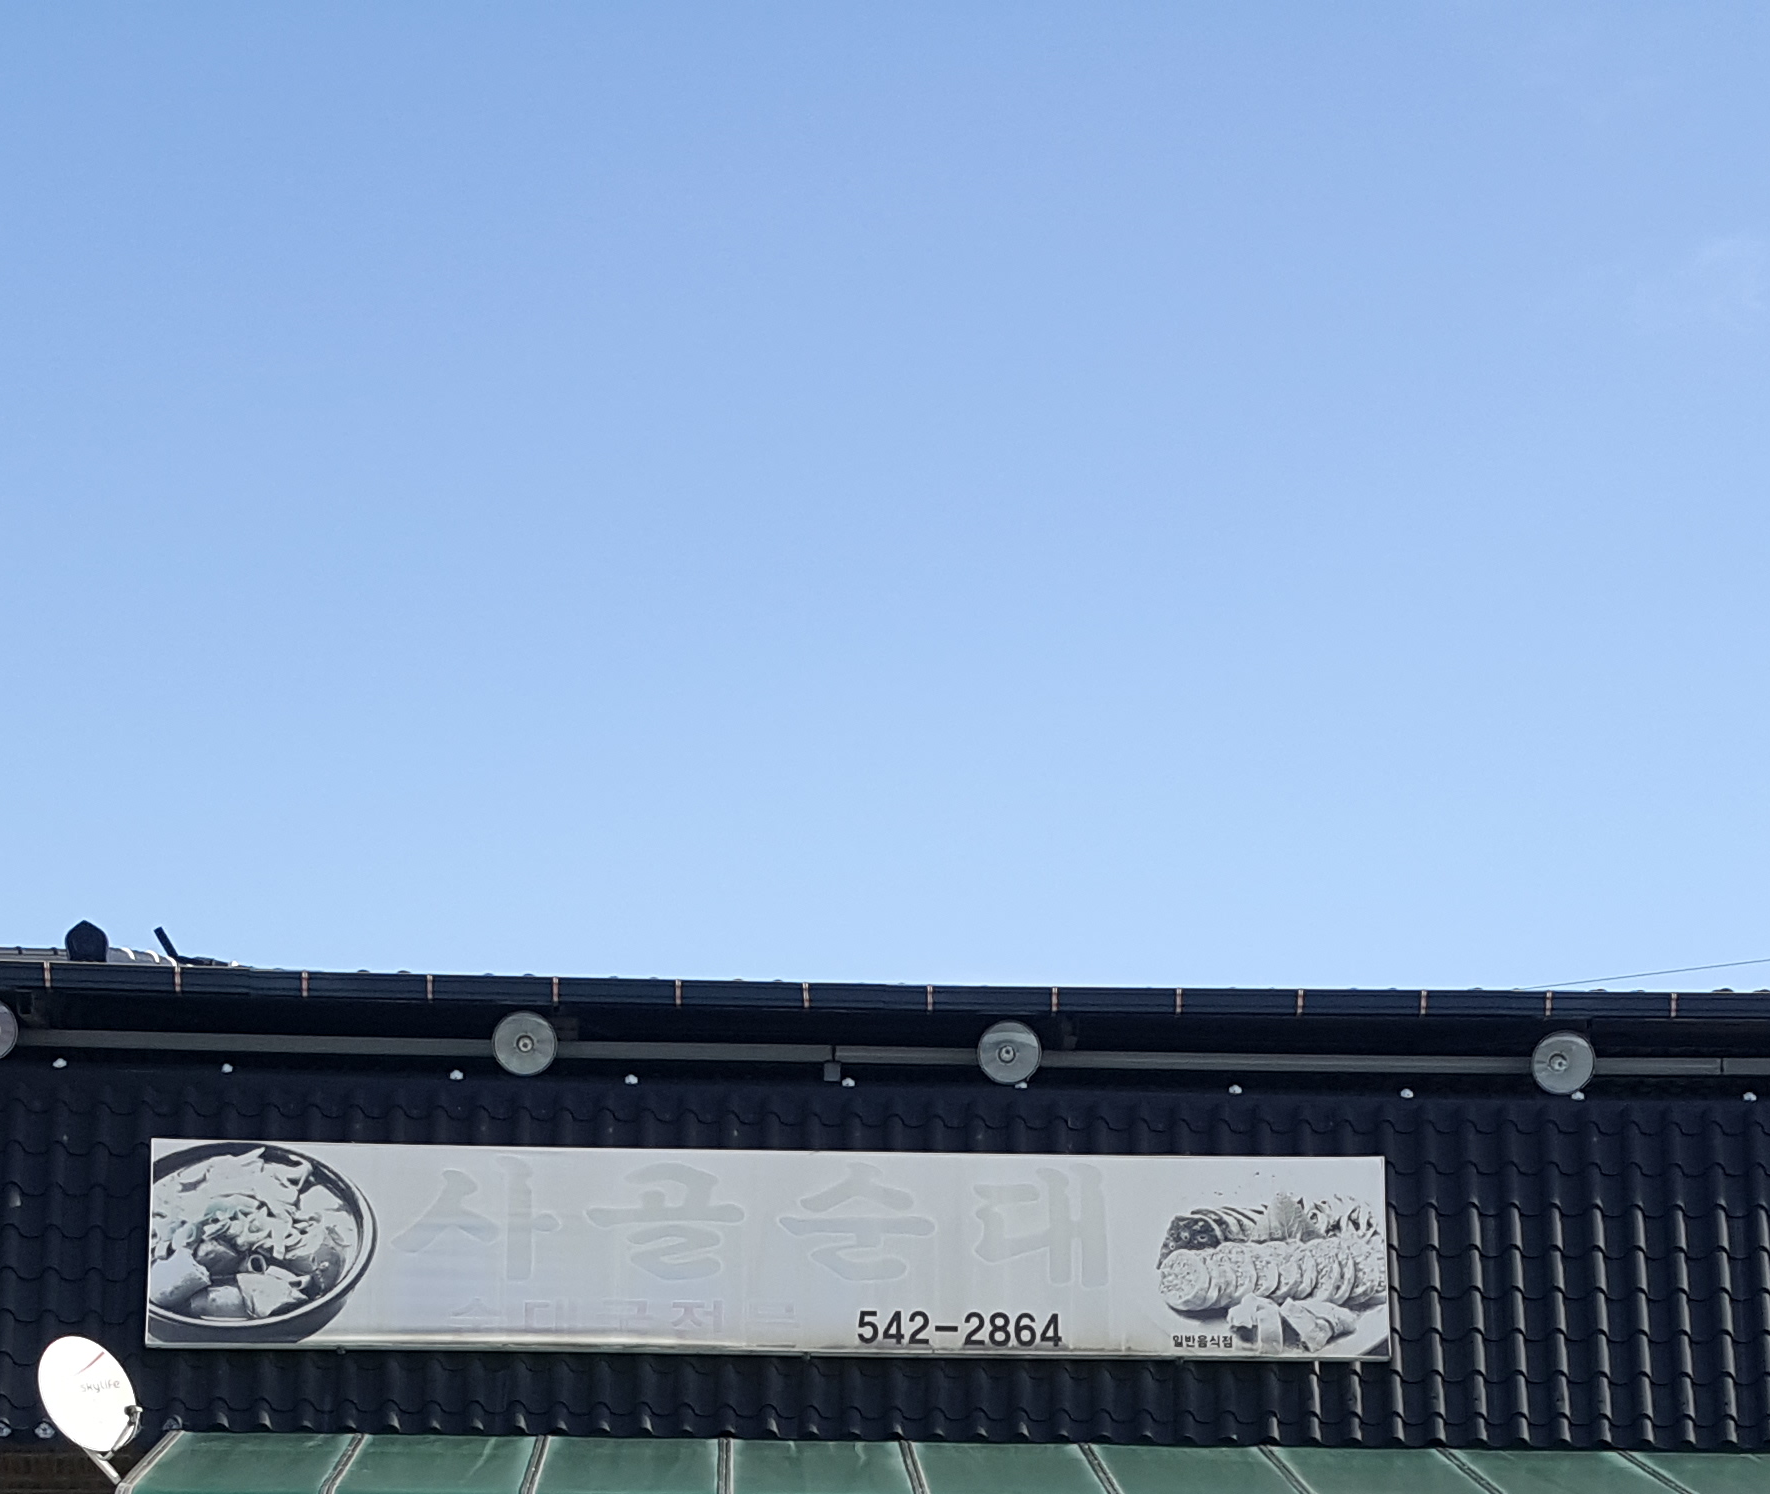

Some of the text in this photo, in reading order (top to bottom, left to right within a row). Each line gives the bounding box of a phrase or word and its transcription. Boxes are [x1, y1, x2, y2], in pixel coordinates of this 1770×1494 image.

[857, 1310, 1063, 1348] 542-2864
[1172, 1334, 1233, 1348] 일반음식점
[80, 1379, 121, 1393] skylife
